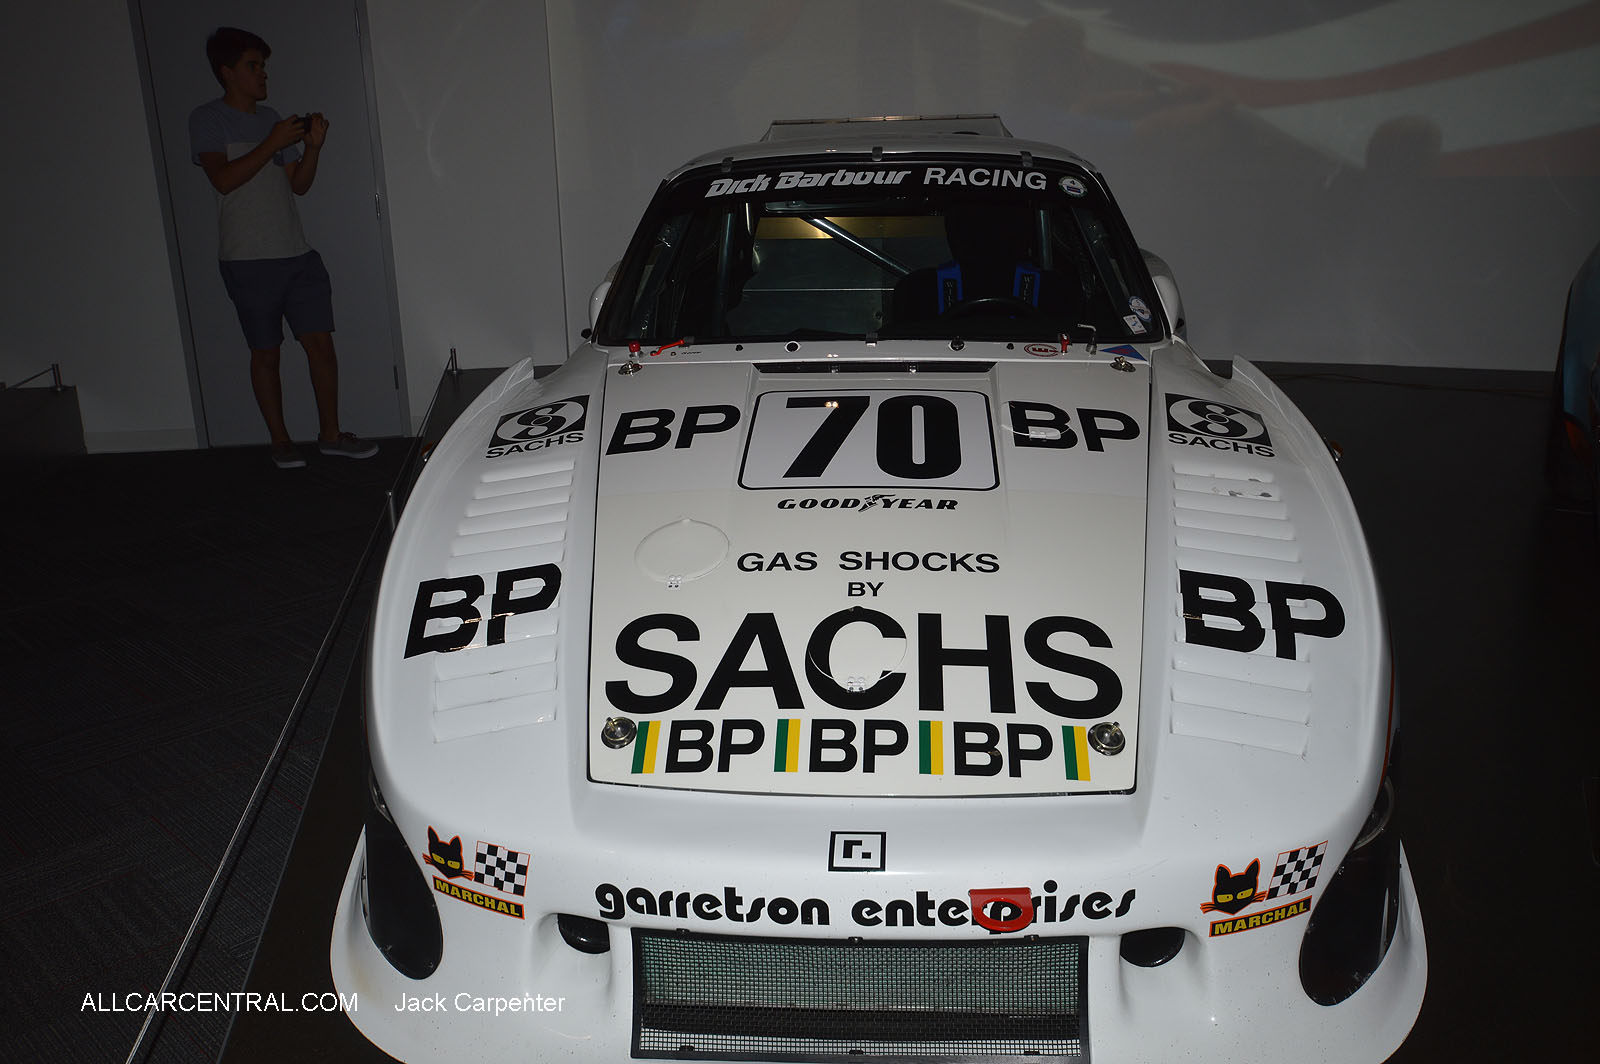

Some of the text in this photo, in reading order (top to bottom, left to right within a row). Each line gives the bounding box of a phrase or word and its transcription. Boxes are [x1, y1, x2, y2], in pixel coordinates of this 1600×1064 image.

[705, 167, 1047, 198] Dick Barbour RACING
[485, 432, 585, 459] SACHS
[605, 404, 741, 456] BP
[782, 394, 962, 480] 70
[1008, 400, 1141, 453] BP
[1168, 432, 1276, 458] SACHS
[736, 550, 1000, 574] GAS SHOCKS
[403, 562, 562, 659] BP
[847, 582, 884, 598] BY
[1179, 569, 1346, 661] BP
[604, 605, 1124, 720] SACHS
[665, 719, 1054, 778] BP BP BP
[435, 879, 521, 917] MARCHAL
[595, 880, 1136, 935] garretson enteprises
[1214, 902, 1308, 935] MARCHAL
